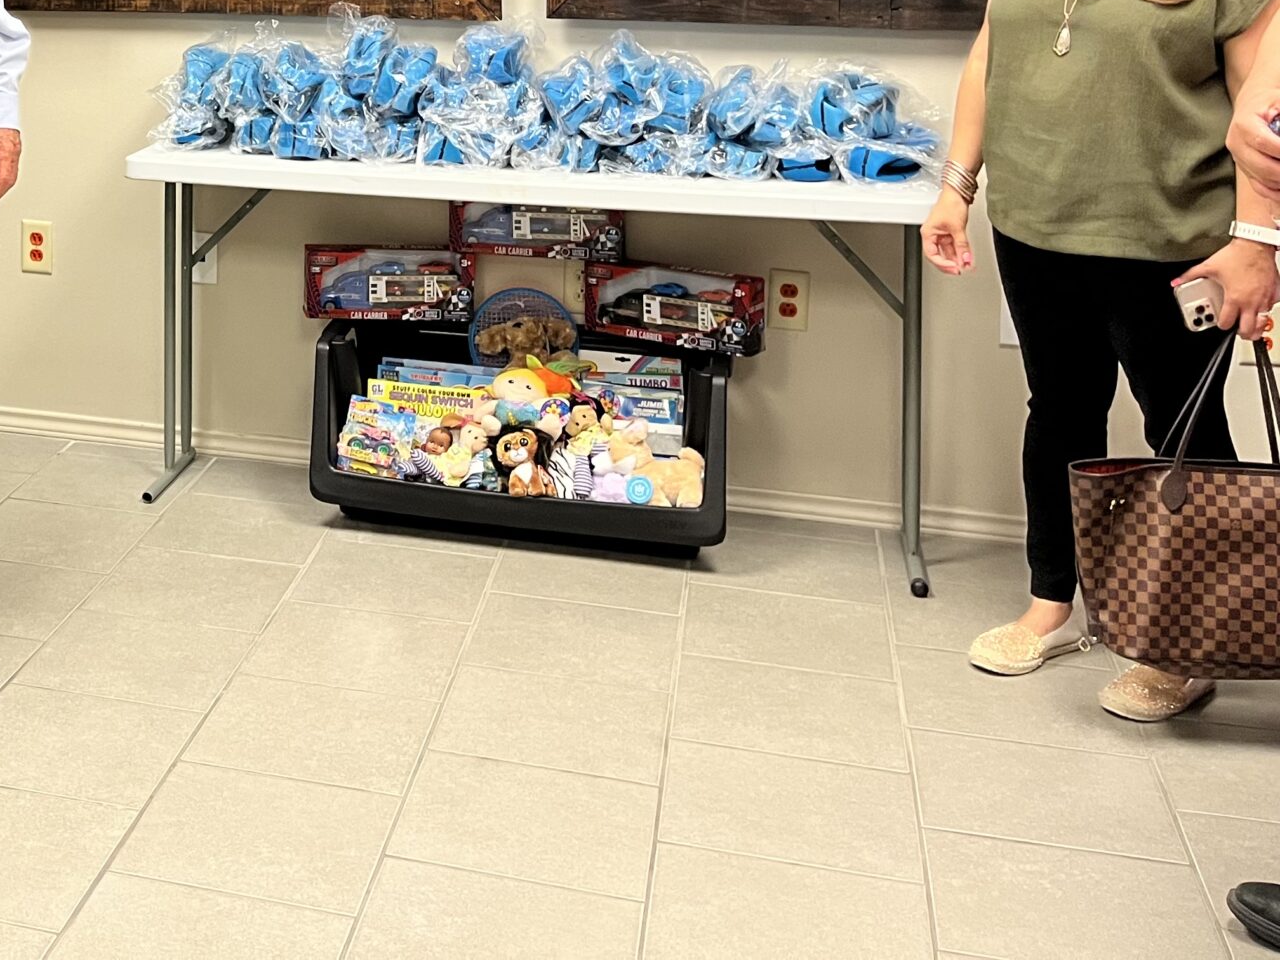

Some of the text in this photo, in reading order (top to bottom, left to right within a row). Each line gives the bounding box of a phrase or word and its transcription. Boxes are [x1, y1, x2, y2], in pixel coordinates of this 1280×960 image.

[494, 246, 533, 256] CAR CARRIER
[350, 311, 388, 320] CAR CARRIER
[625, 328, 663, 342] CAR CARRIER
[389, 391, 474, 409] SEQUIN SWITCH
